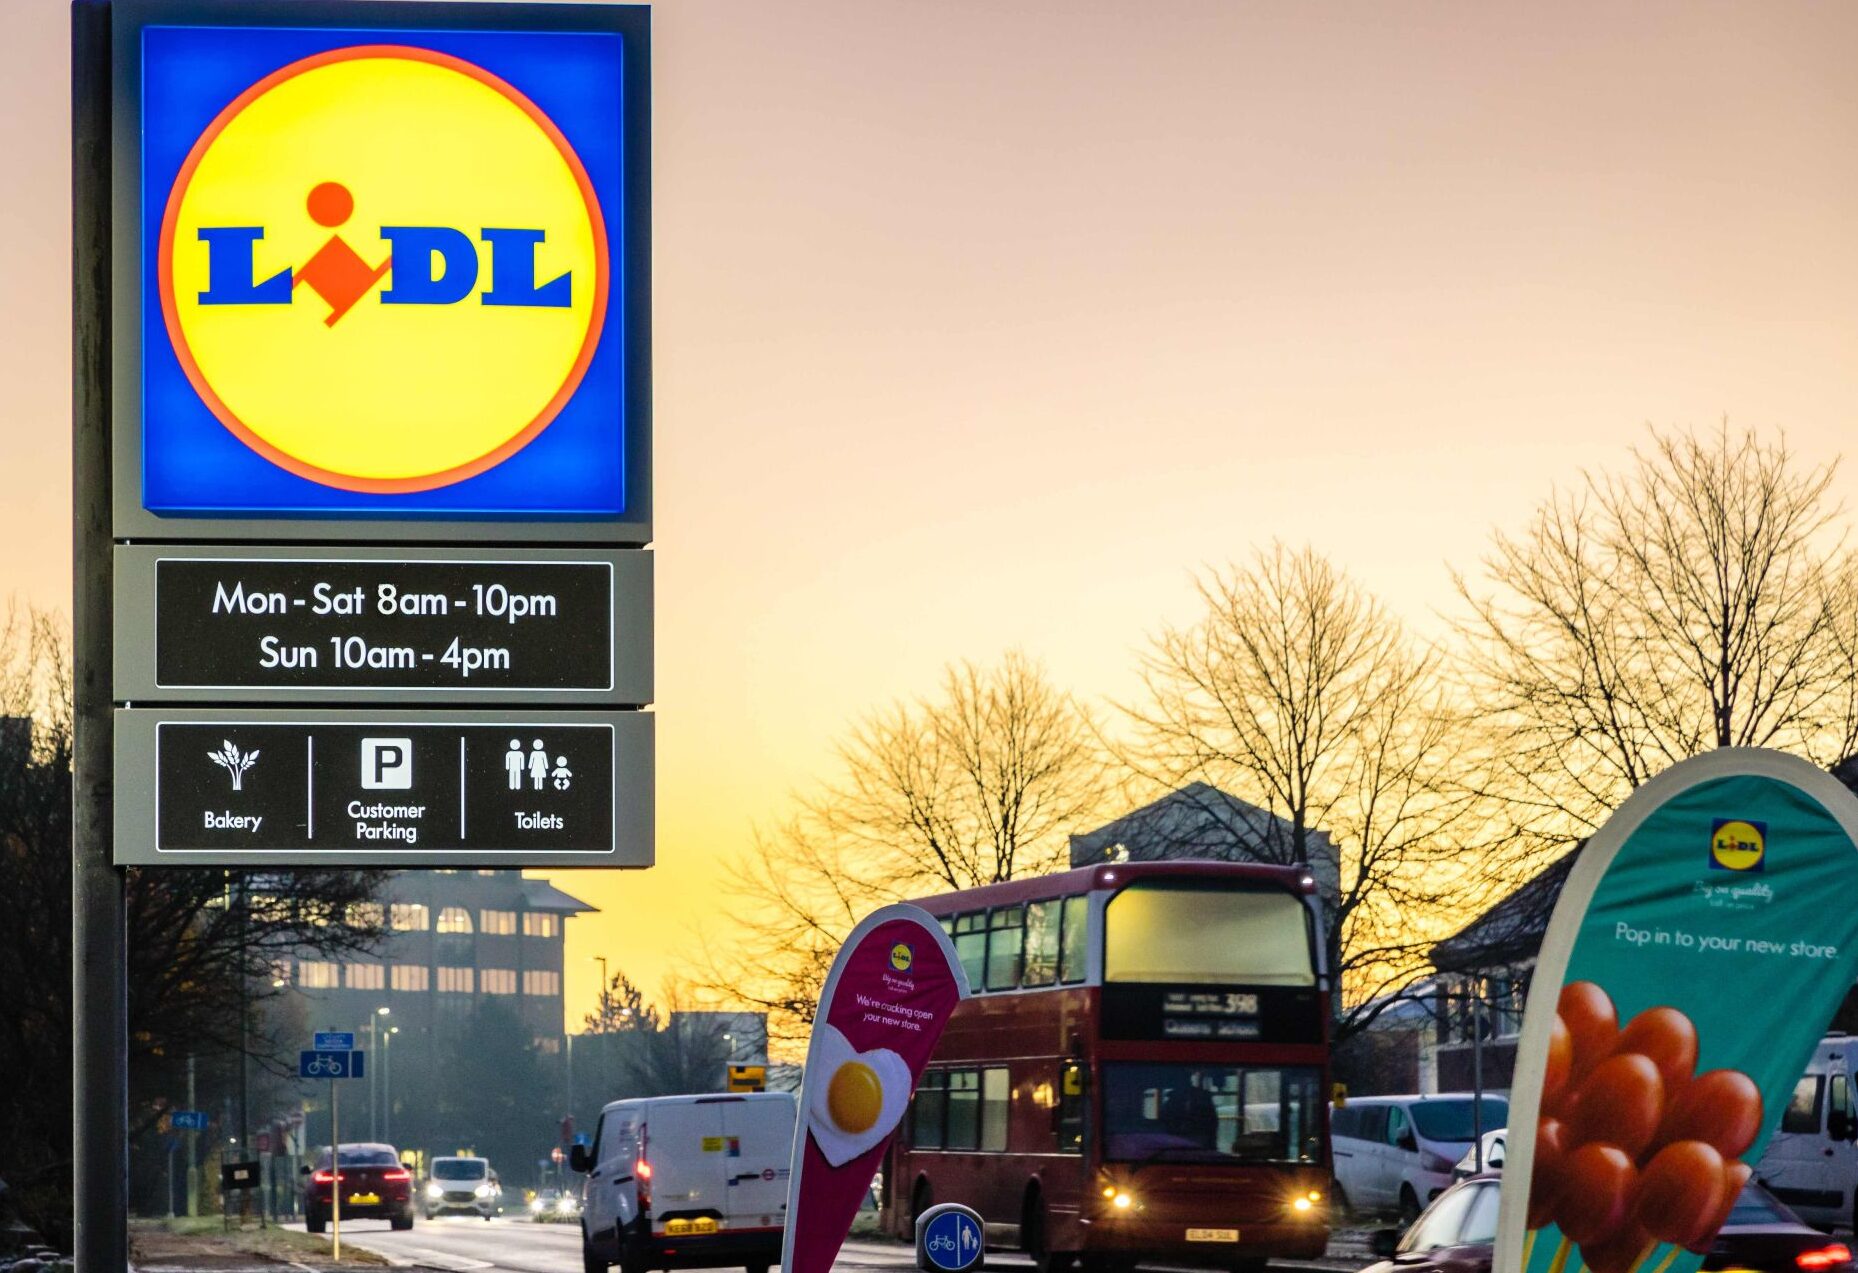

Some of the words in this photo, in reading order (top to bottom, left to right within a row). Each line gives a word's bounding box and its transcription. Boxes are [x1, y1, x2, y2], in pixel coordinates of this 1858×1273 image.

[259, 636, 317, 669] Sun
[374, 745, 403, 783] P
[347, 801, 426, 820] Customer
[514, 811, 564, 830] Toilets
[204, 811, 263, 833] Bakery
[356, 822, 417, 844] Parking
[1615, 922, 1651, 947] Pop
[1655, 928, 1670, 945] in
[1675, 930, 1694, 947] to
[1698, 935, 1741, 952] your
[1745, 939, 1786, 955] new
[856, 993, 880, 1009] We're
[880, 1001, 913, 1018] cracking
[913, 1010, 934, 1021] open
[863, 1012, 881, 1023] your
[882, 1016, 900, 1026] new
